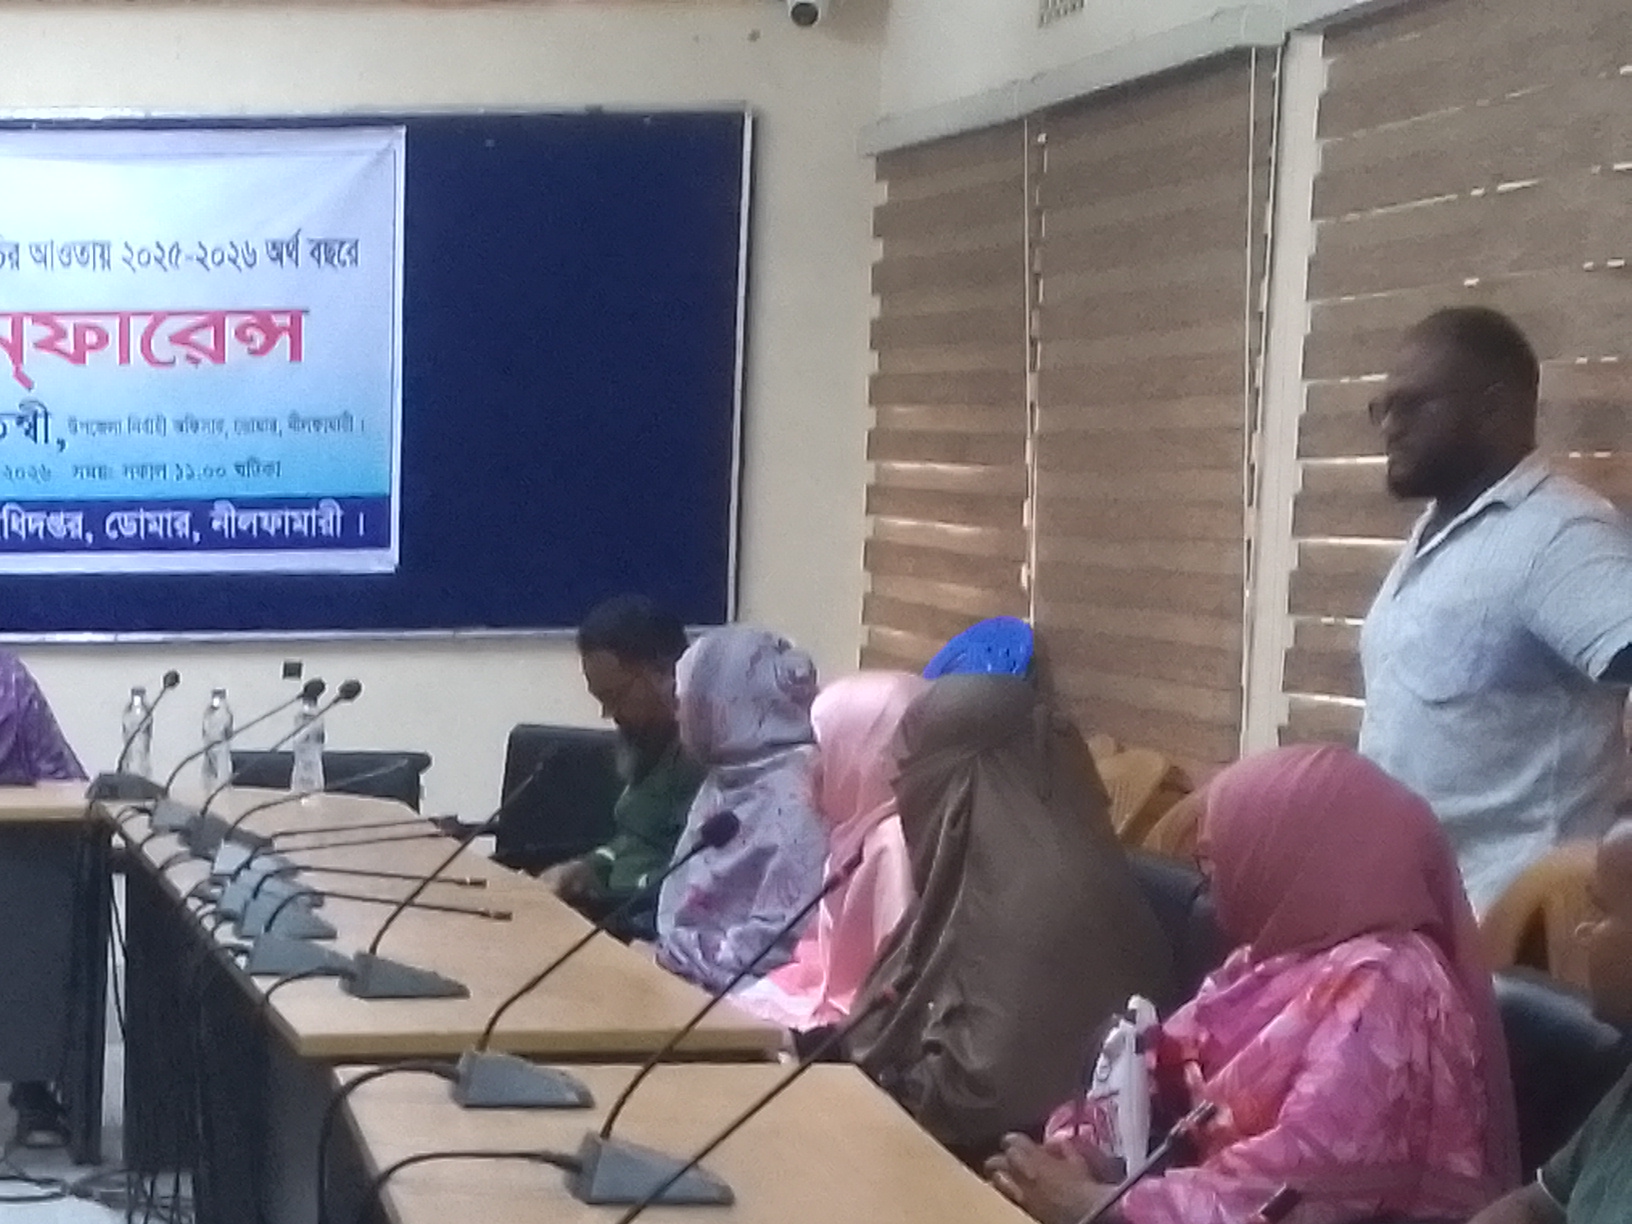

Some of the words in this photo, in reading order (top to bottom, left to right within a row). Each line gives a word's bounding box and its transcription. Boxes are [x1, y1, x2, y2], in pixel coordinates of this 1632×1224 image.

[28, 239, 112, 272] আওতায়
[122, 239, 258, 273] ২০২৫-২০২৬
[265, 228, 302, 270] অর্থ
[307, 238, 360, 268] বছরে
[105, 508, 202, 545] ডোমার,
[210, 499, 344, 539] নীলফামারী
